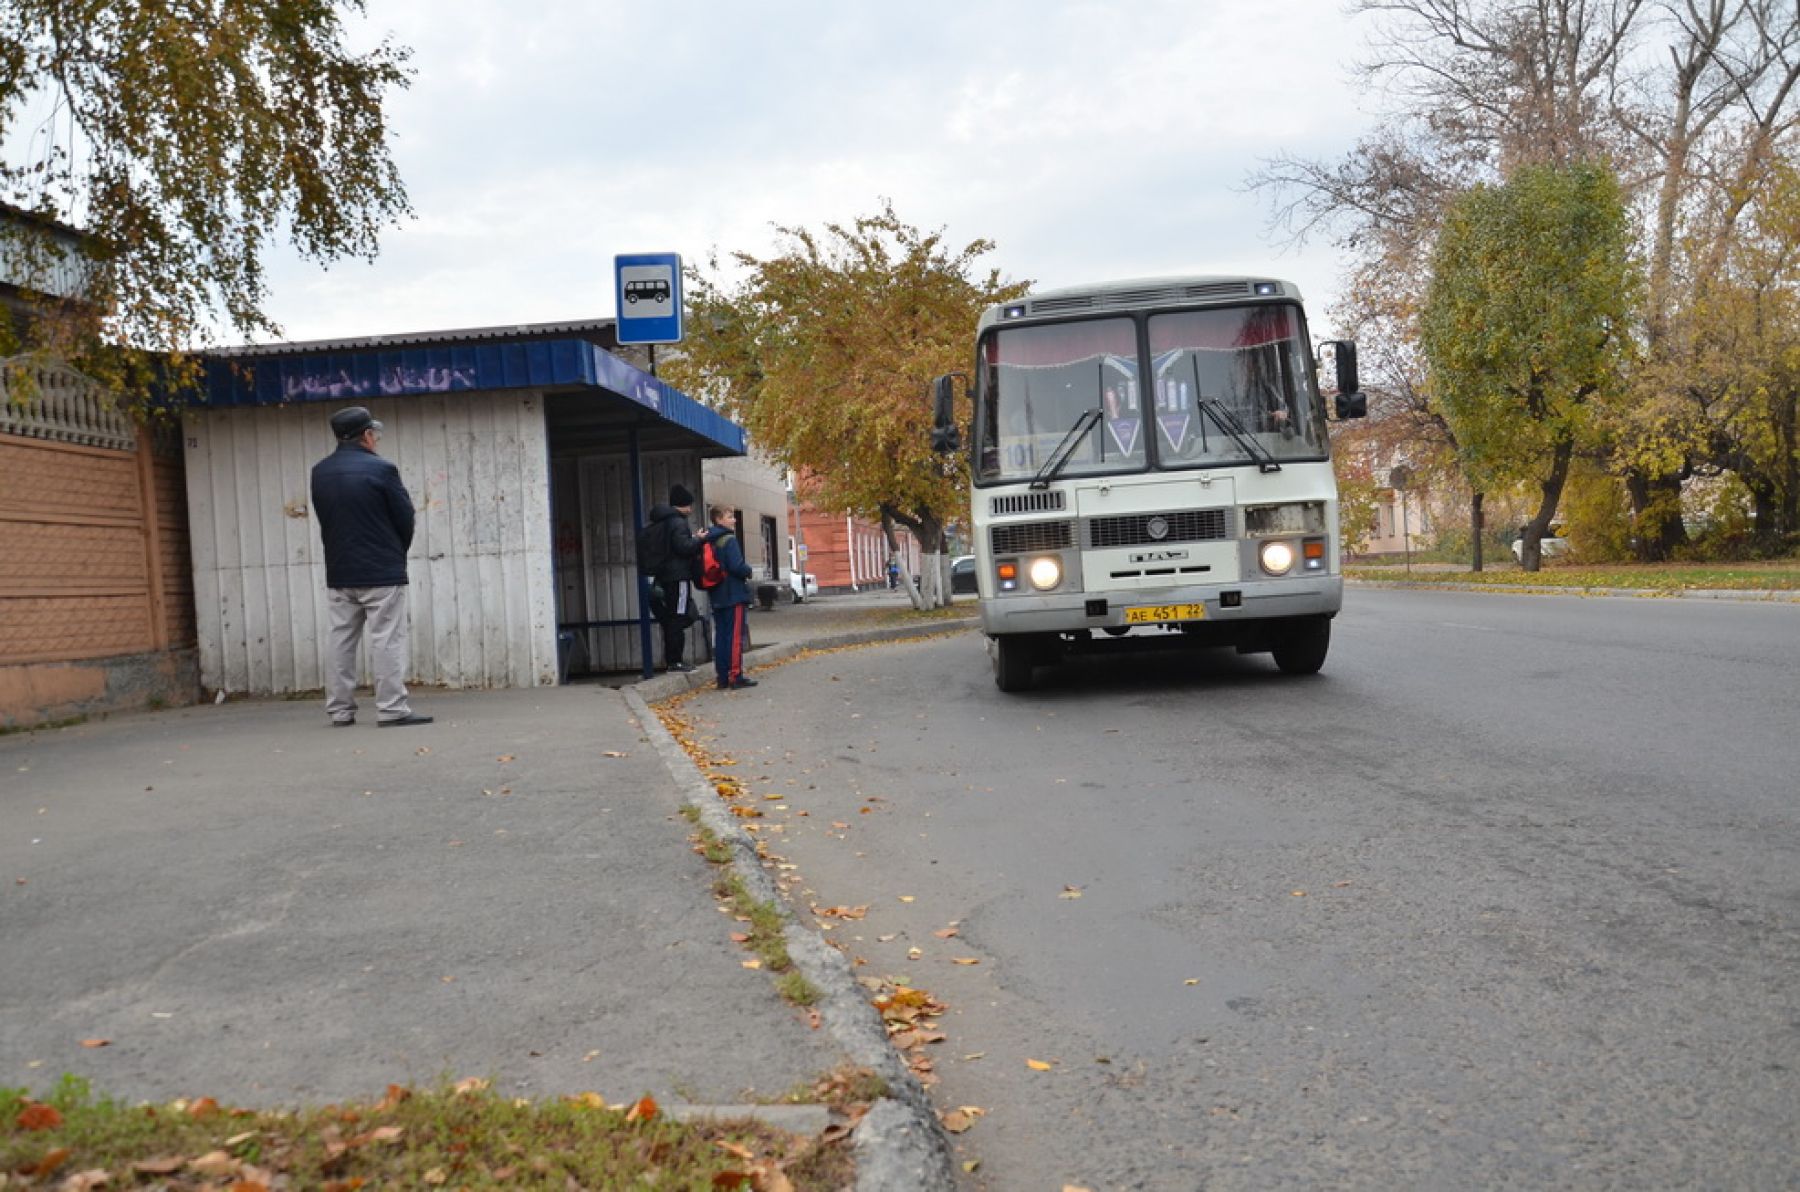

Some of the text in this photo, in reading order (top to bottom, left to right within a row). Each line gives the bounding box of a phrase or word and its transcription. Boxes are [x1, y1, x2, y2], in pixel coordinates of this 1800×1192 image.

[1007, 443, 1034, 467] 101
[1153, 606, 1178, 620] 451
[1186, 603, 1200, 614] 22
